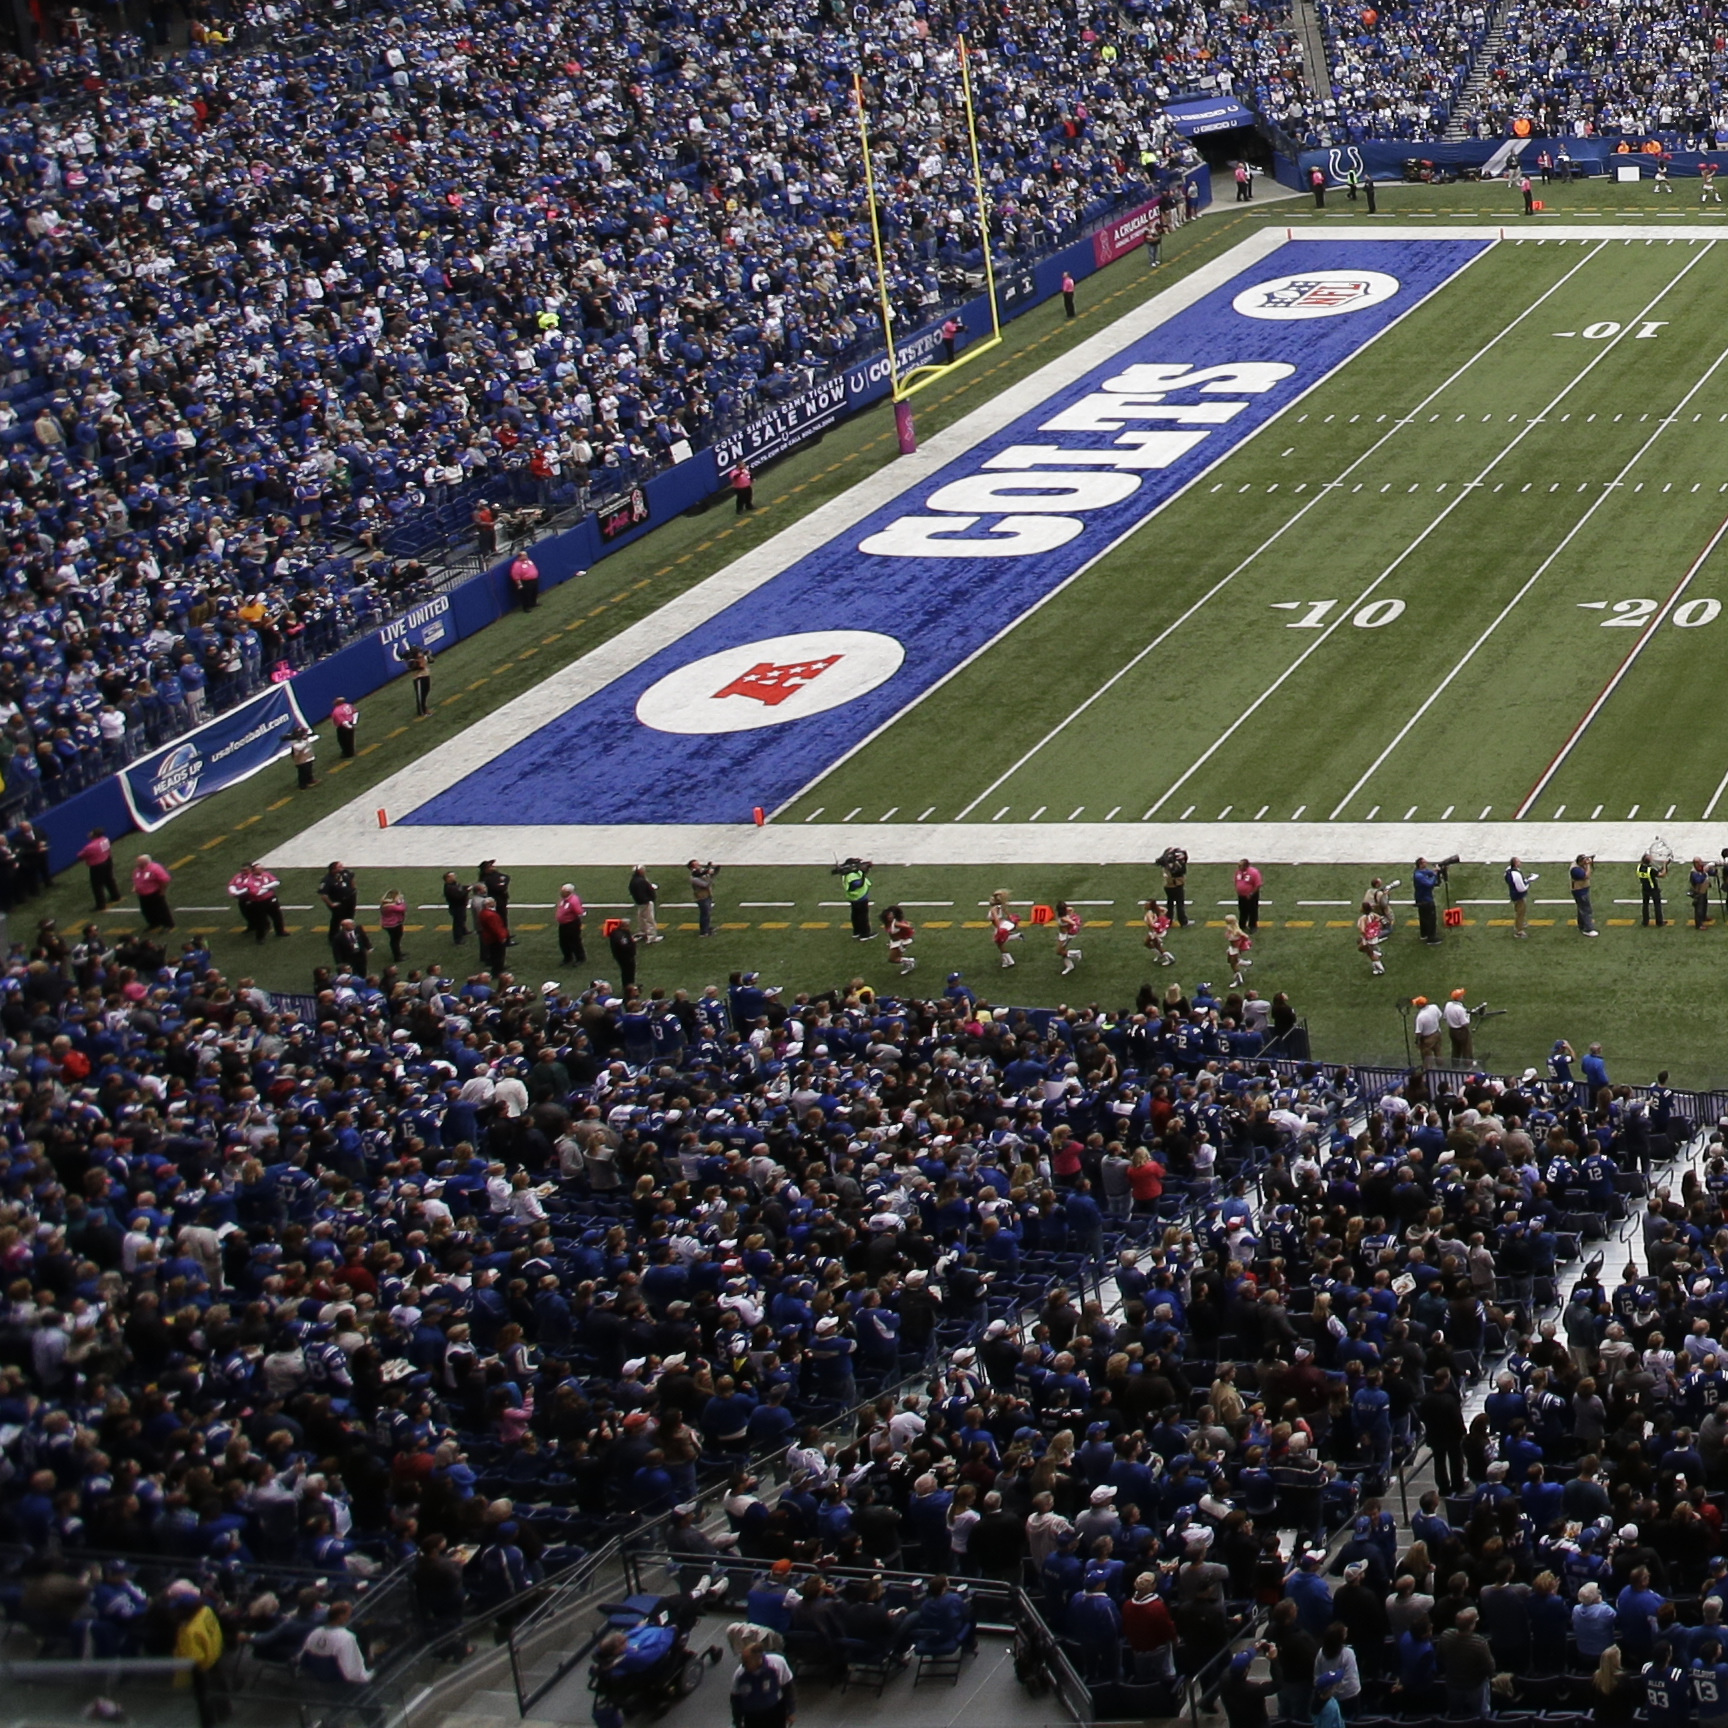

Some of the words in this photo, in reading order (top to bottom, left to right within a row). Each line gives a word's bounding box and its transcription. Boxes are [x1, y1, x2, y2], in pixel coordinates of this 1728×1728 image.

[1121, 215, 1148, 237] CRUCIAL
[1305, 280, 1363, 309] NFL
[714, 431, 744, 453] COLTS
[746, 413, 780, 436] SINGLE
[781, 396, 807, 415] GAME
[808, 375, 845, 400] TICKETS
[717, 444, 744, 467] ON
[752, 411, 798, 447] SALE
[805, 383, 846, 416] NOW
[857, 361, 1298, 559] COLTS
[379, 622, 408, 646] LIVE
[408, 595, 450, 629] UNITED
[1285, 599, 1406, 630] 10
[1600, 598, 1721, 629] 20
[211, 713, 290, 763] usafootball.com
[153, 765, 188, 796] HEADS
[188, 760, 204, 777] UP
